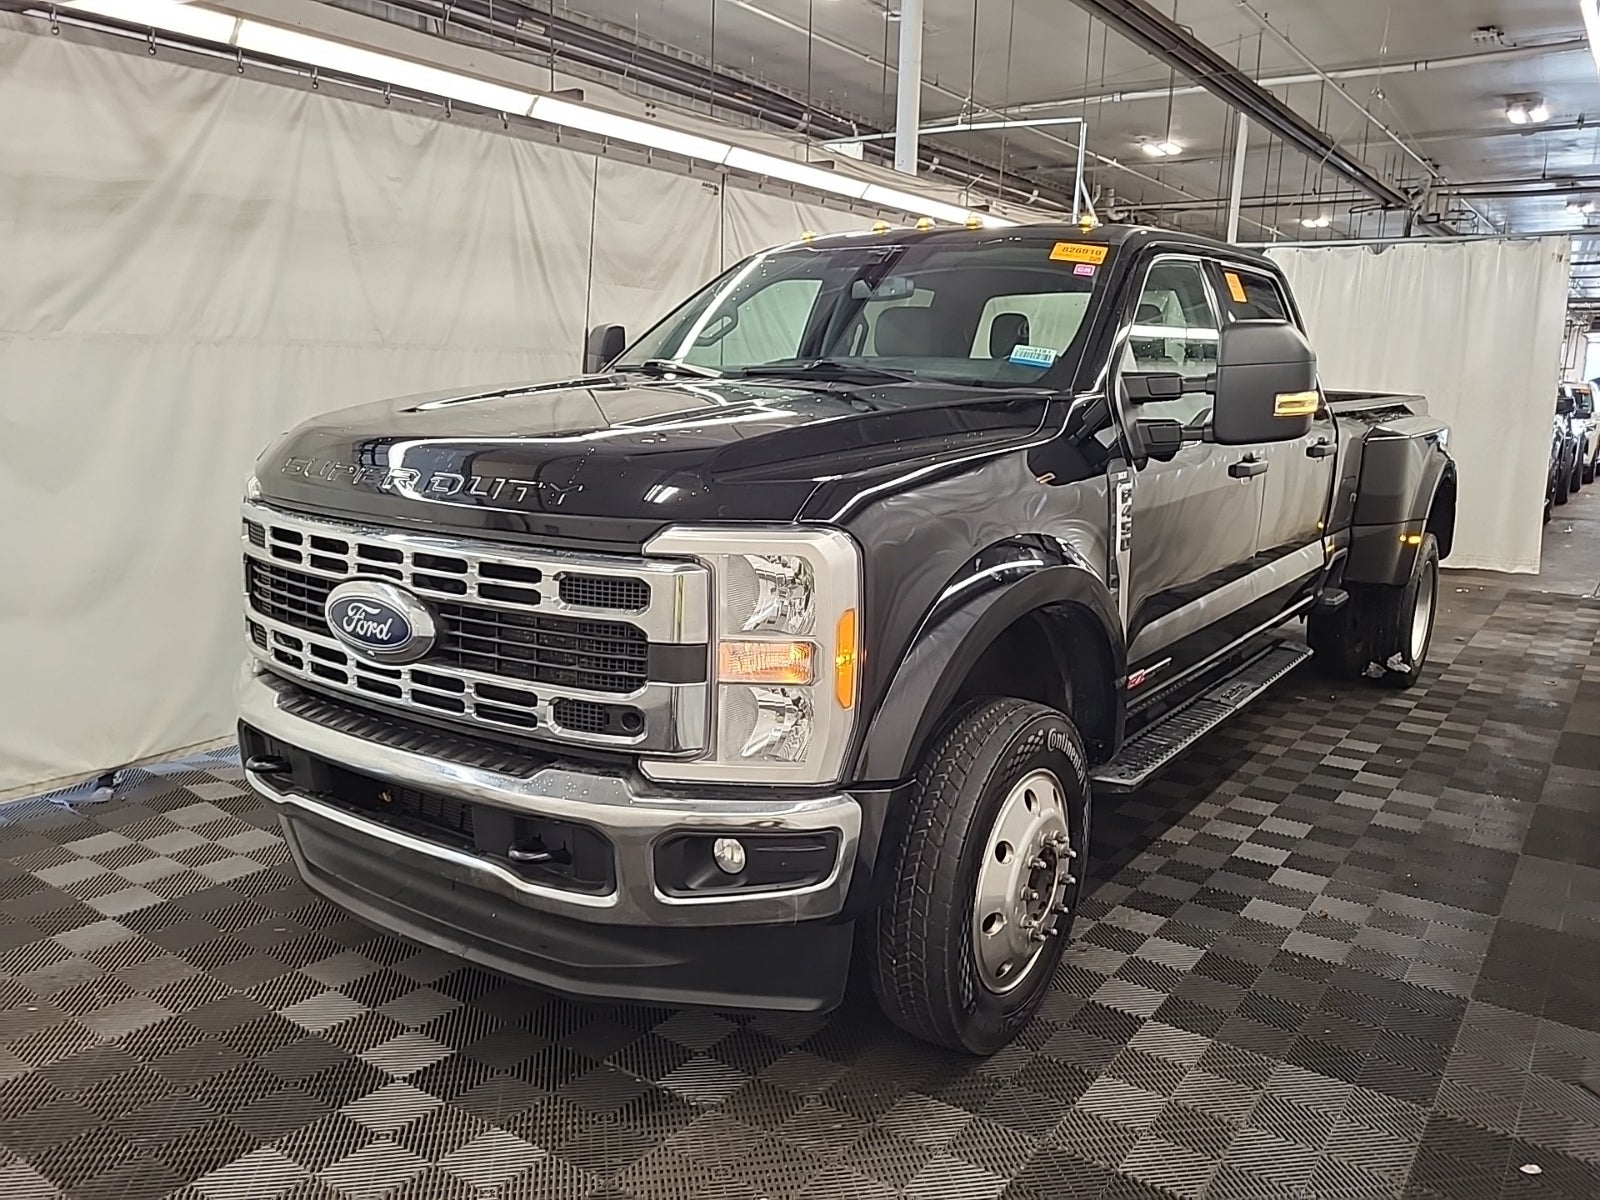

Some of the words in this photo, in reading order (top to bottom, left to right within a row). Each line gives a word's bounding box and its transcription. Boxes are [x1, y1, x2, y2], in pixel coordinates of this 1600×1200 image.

[1062, 246, 1102, 256] 826910
[281, 456, 421, 497] SUPER
[427, 470, 585, 505] DUTY
[342, 602, 394, 641] Ford
[1047, 727, 1086, 786] Continental
